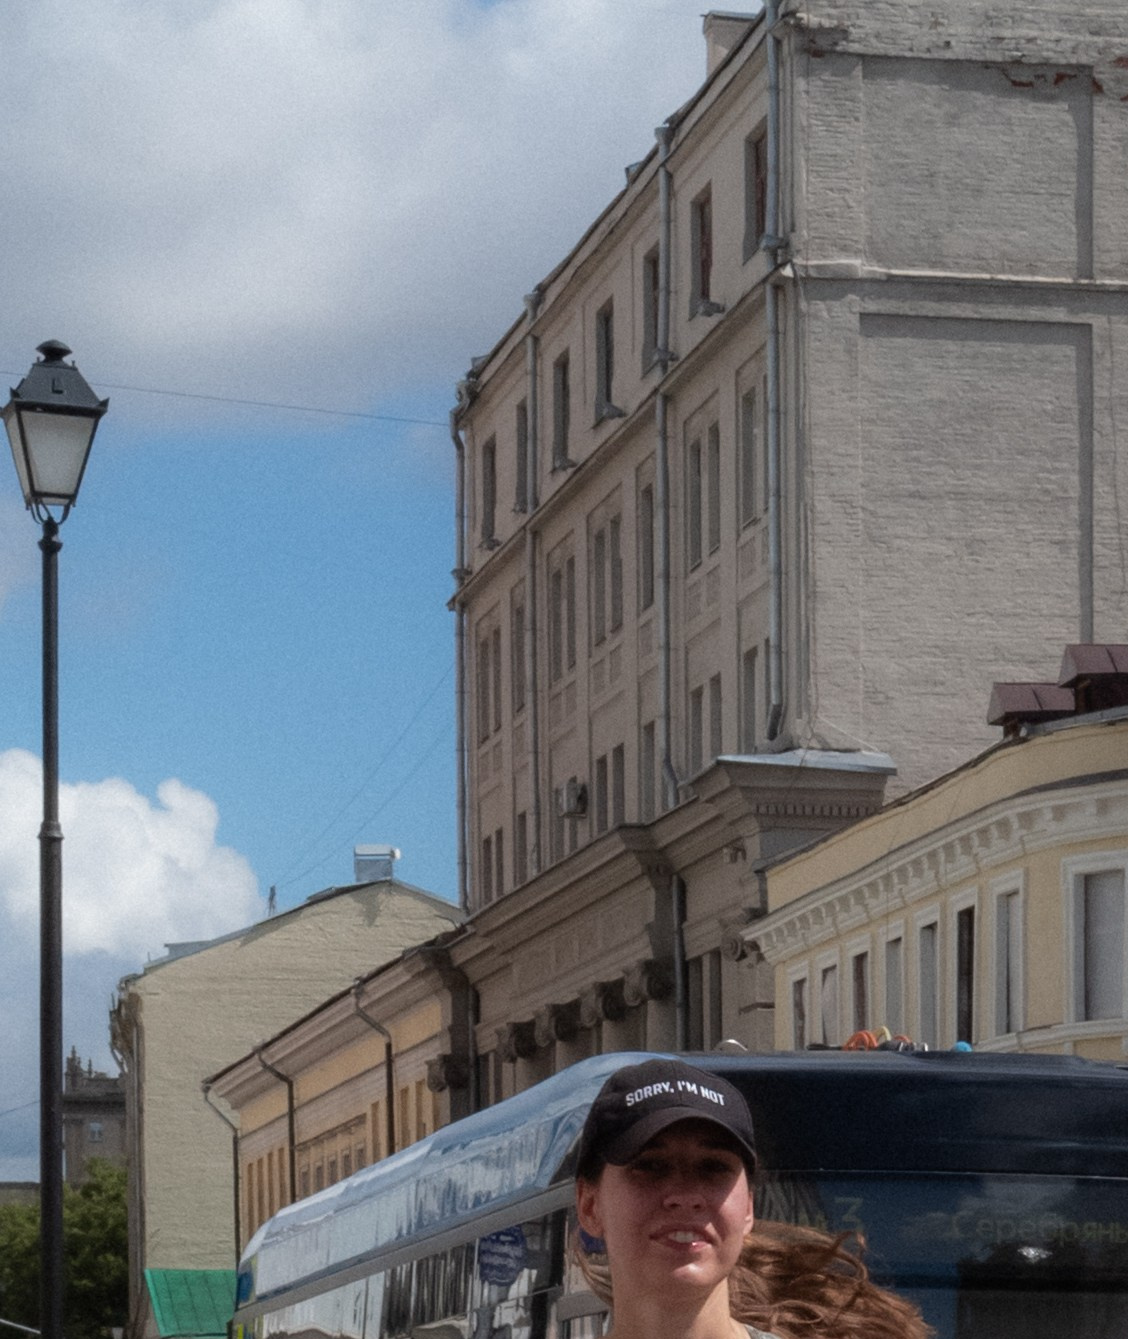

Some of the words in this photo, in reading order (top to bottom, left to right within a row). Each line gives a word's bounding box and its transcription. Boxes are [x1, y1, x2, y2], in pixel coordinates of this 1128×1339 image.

[625, 1081, 675, 1107] SORRY,
[677, 1080, 698, 1095] I'M
[700, 1086, 725, 1106] NOT
